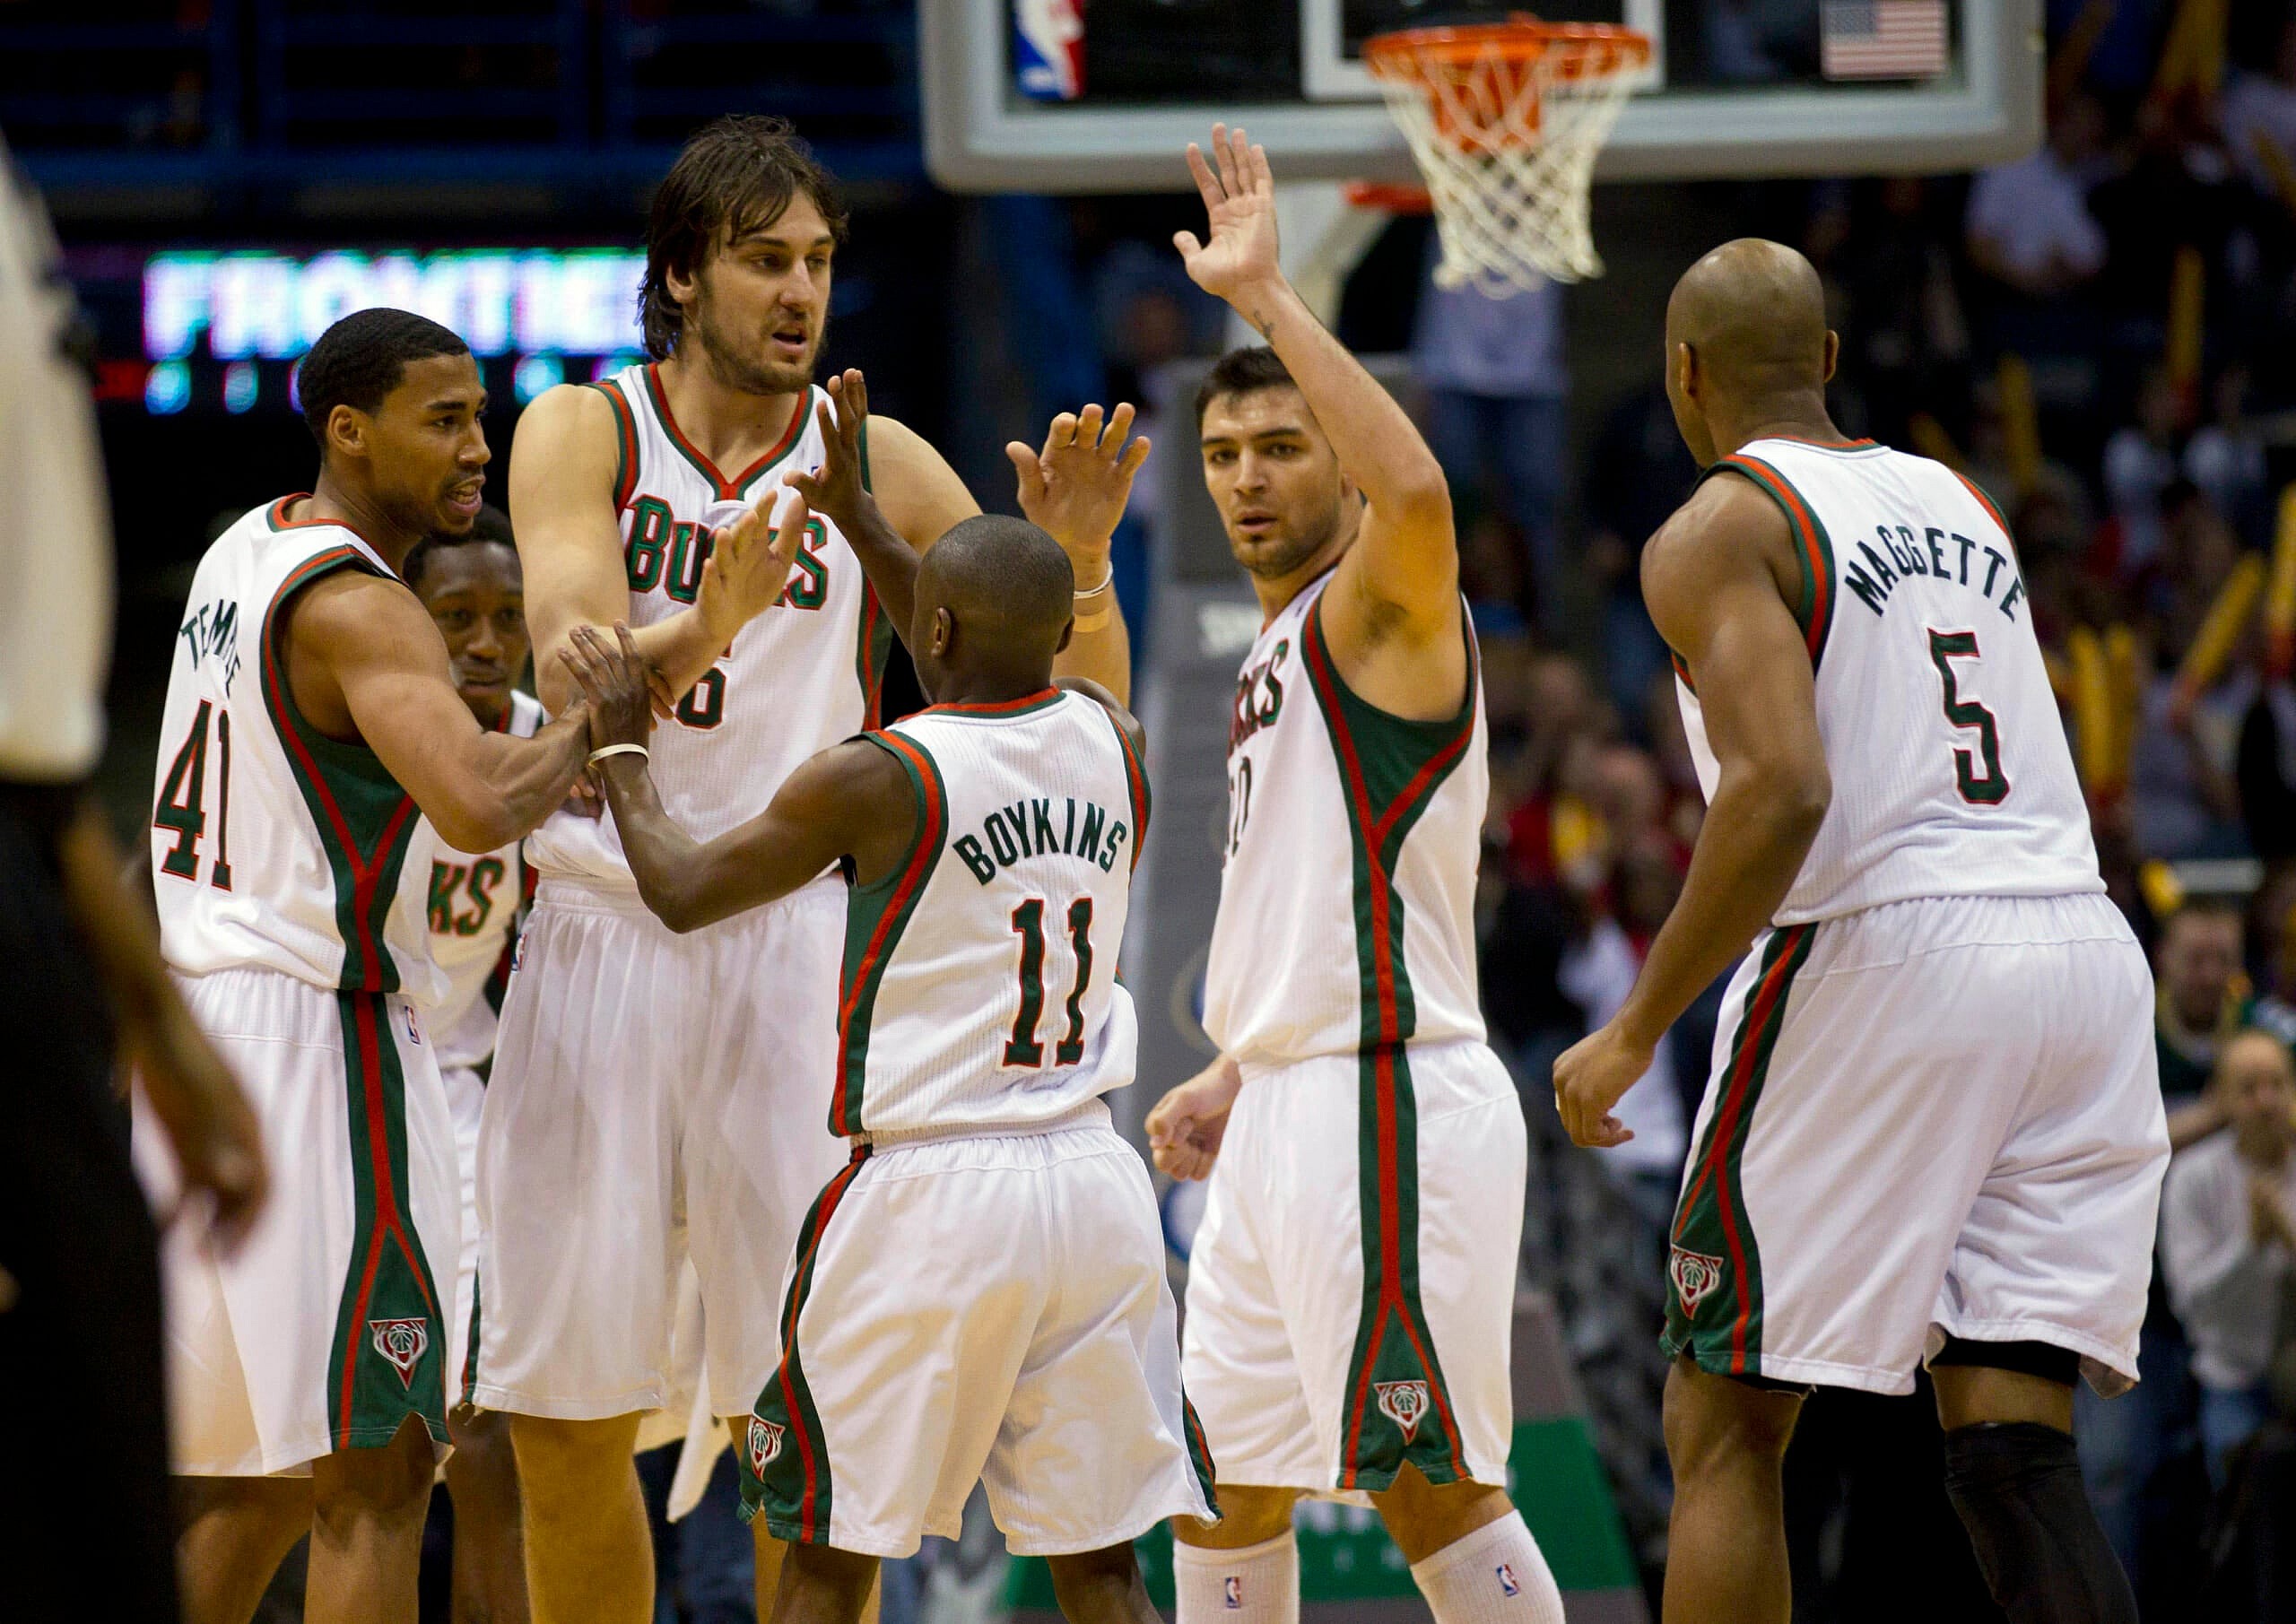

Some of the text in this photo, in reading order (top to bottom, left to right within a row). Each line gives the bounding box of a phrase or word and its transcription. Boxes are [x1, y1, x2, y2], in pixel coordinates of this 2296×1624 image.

[628, 494, 830, 611] BUS
[1844, 525, 2027, 623] MAGGETTE
[1927, 628, 2011, 805] 5
[152, 699, 232, 892] 41
[952, 798, 1128, 886] BOYKINS
[1002, 897, 1093, 1068] 11
